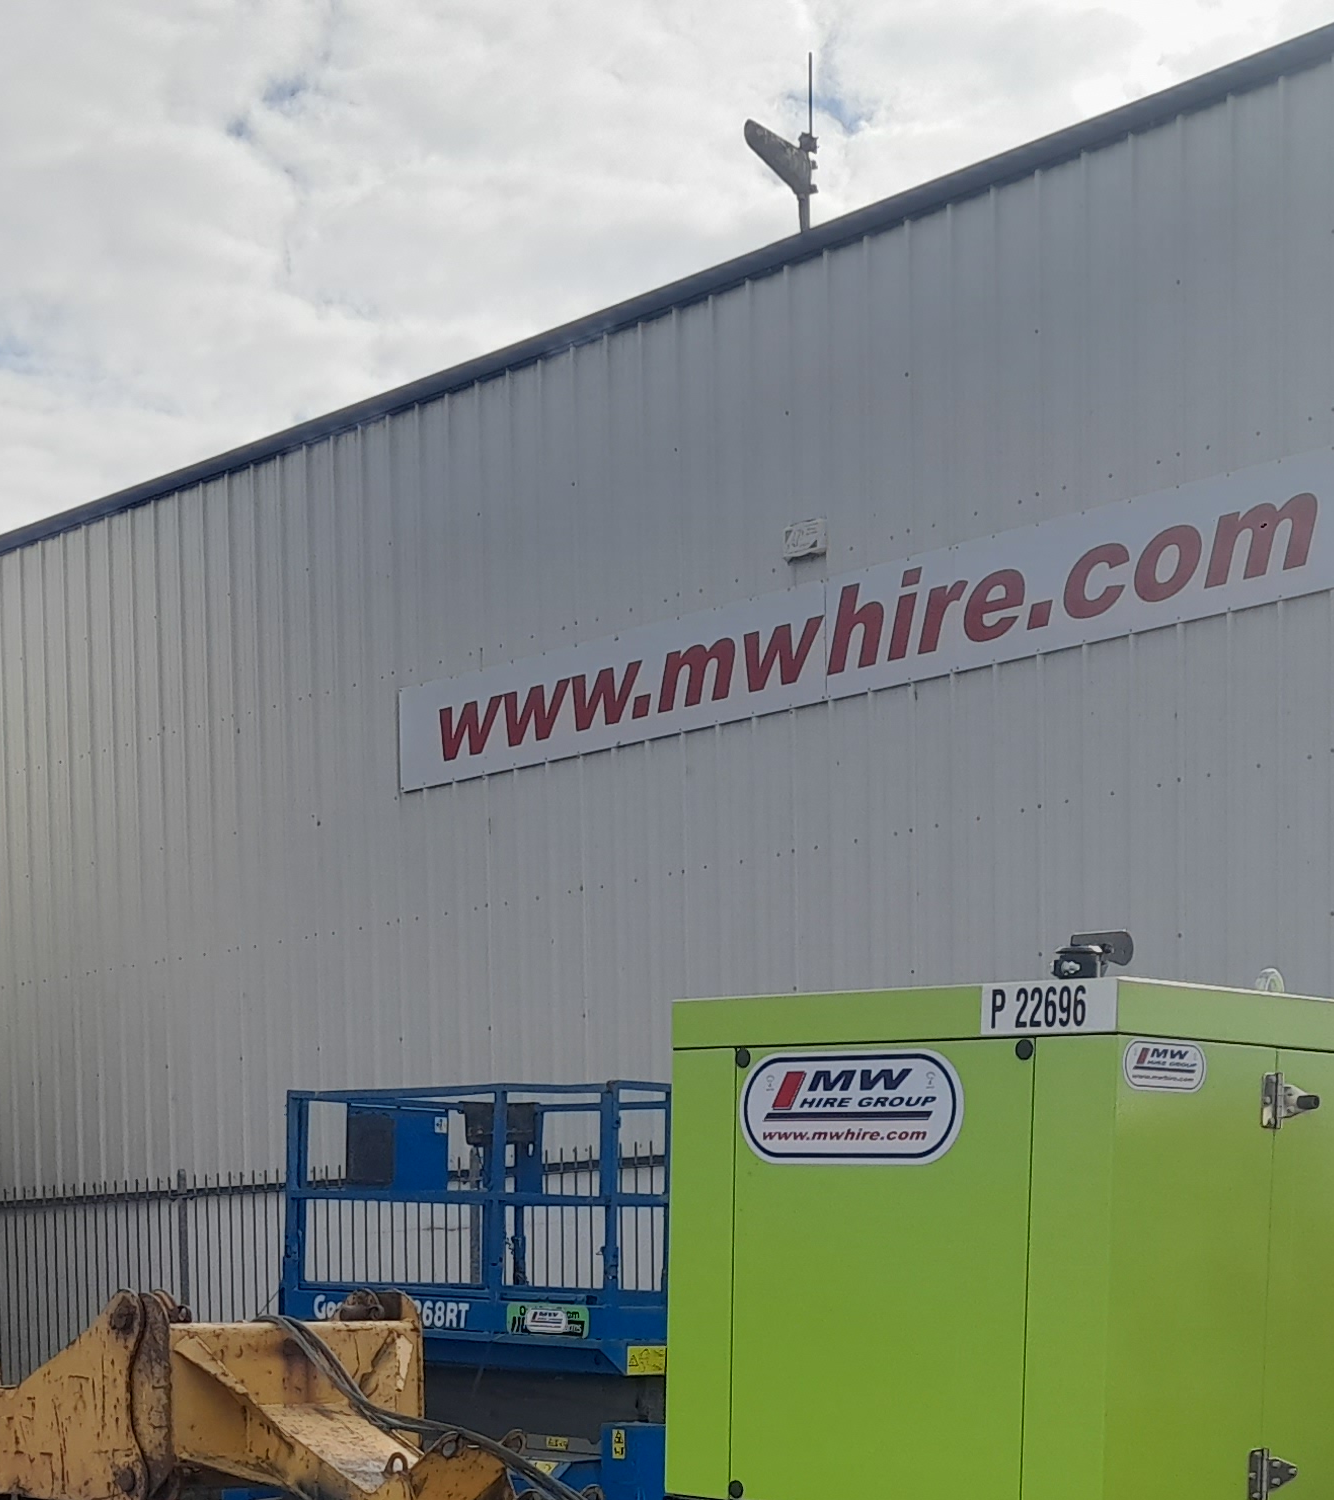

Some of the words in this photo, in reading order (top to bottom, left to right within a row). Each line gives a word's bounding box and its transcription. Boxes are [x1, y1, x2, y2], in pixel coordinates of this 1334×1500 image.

[438, 489, 1320, 762] www.mwhire.com
[990, 988, 1007, 1029] P
[1014, 984, 1087, 1028] 22696
[1151, 1048, 1190, 1060] MW
[807, 1067, 914, 1092] MW
[799, 1097, 853, 1109] HIRE
[856, 1095, 938, 1108] GROUP
[762, 1127, 928, 1141] www.mwhire.com
